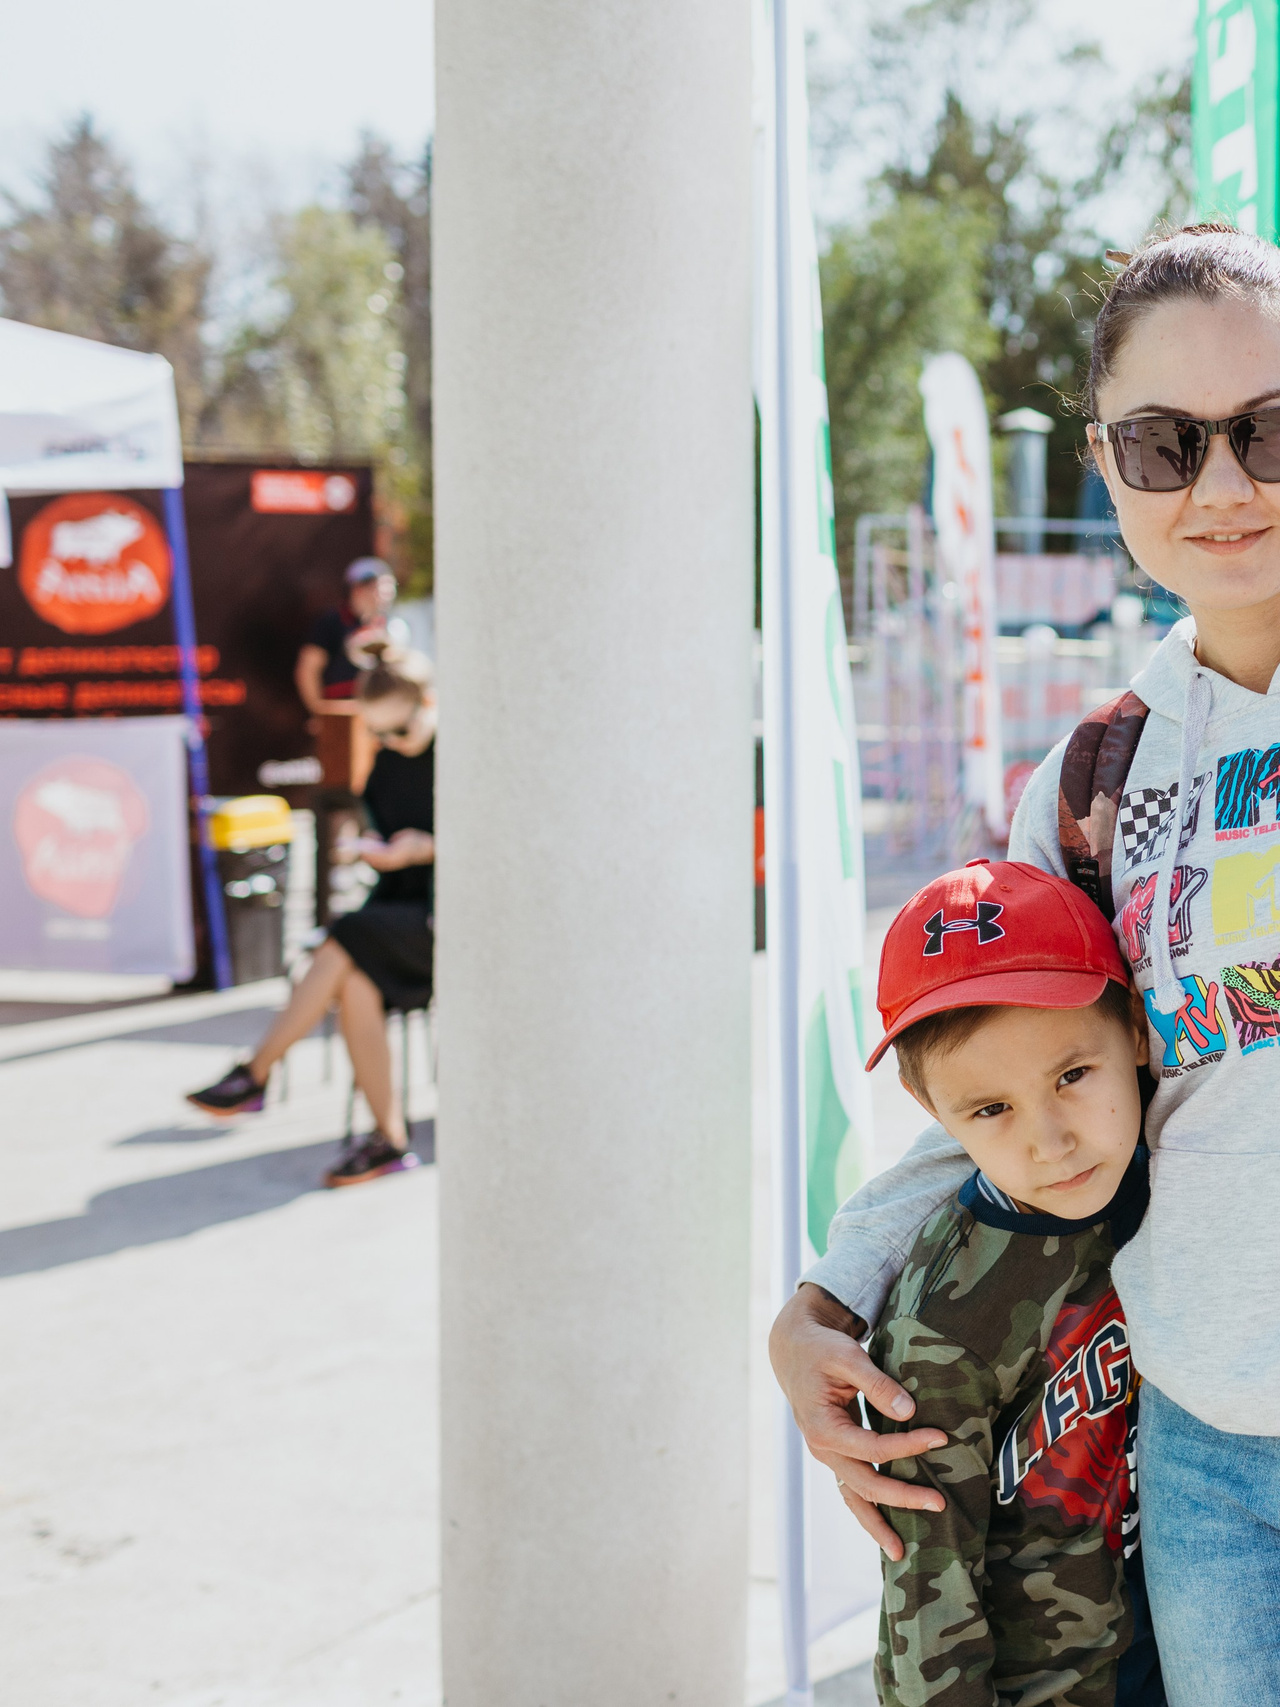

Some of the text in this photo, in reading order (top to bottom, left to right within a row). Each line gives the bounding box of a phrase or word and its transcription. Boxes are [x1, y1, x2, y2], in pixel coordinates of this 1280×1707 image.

[1215, 828, 1250, 842] MUSIC
[1214, 932, 1247, 946] MUSIC
[1143, 974, 1229, 1067] MTV
